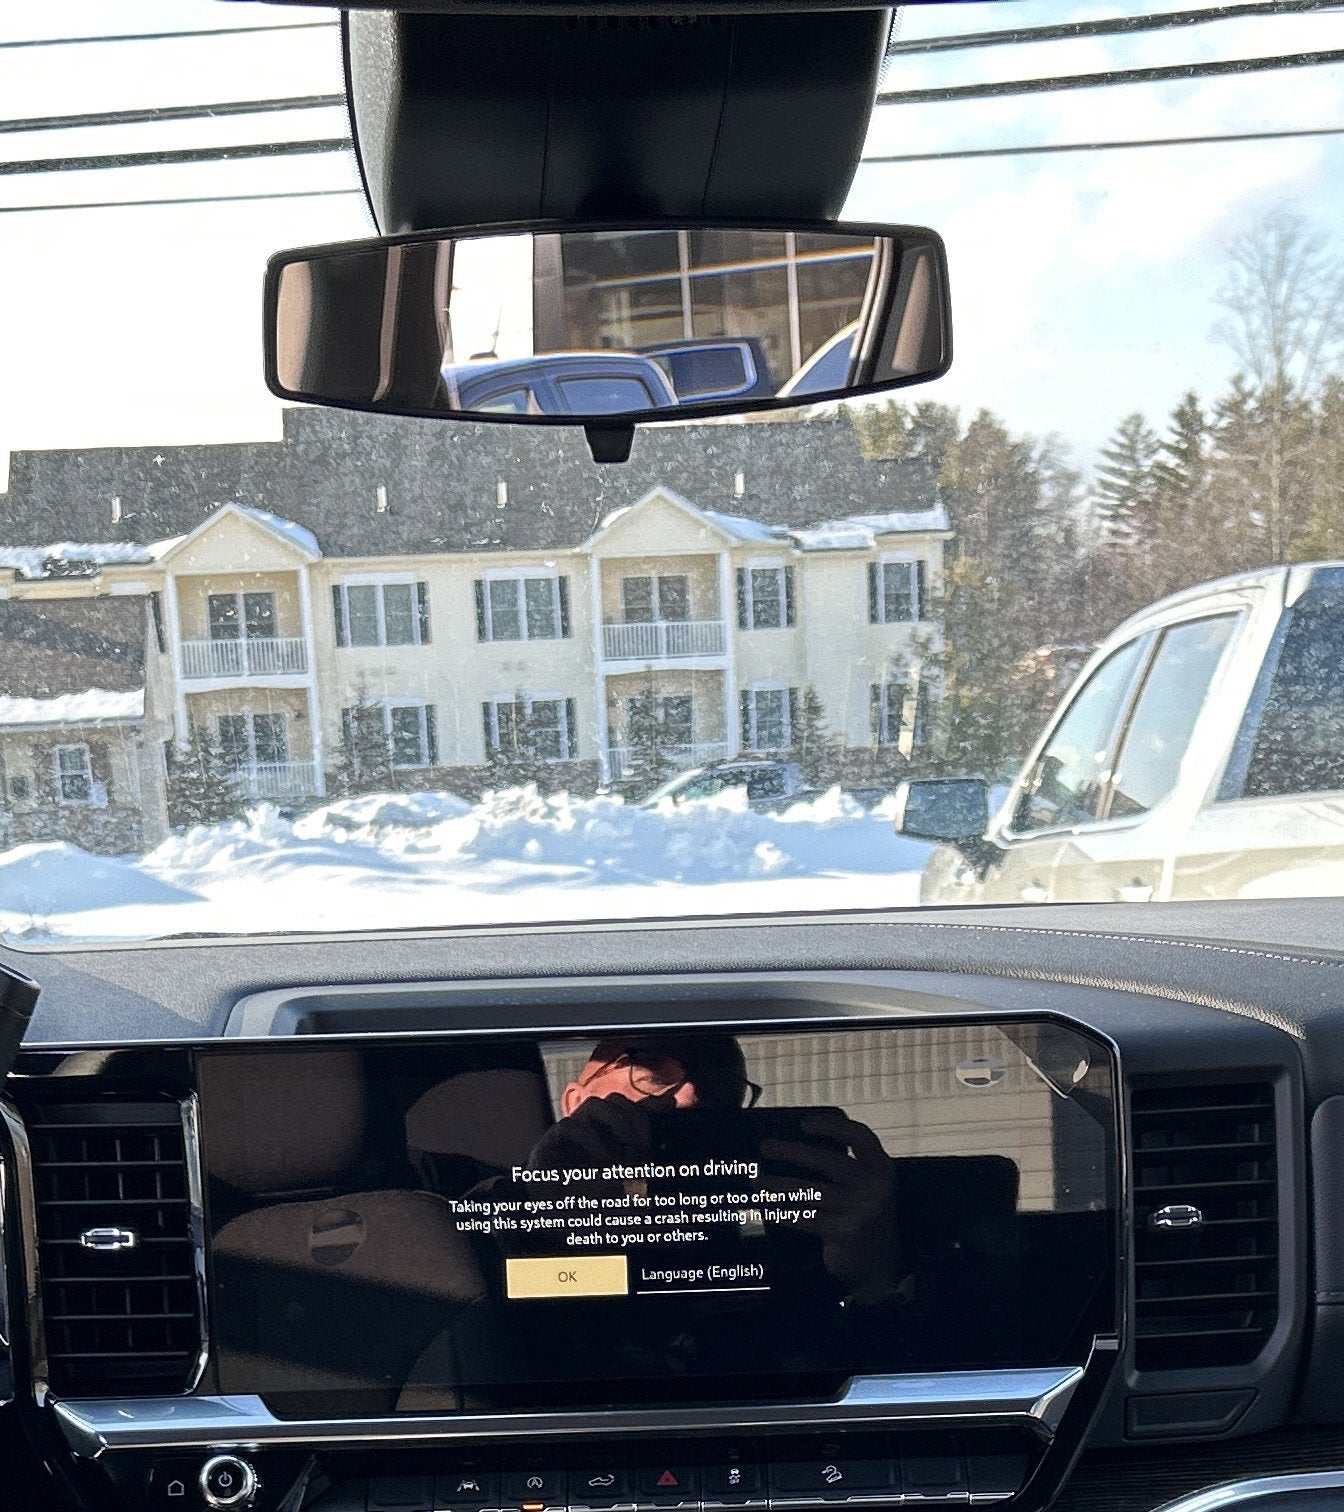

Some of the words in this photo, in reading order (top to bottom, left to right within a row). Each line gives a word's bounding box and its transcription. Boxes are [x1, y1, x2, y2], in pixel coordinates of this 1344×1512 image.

[512, 1166, 560, 1182] Focus
[562, 1168, 599, 1185] your
[602, 1162, 675, 1179] attention
[679, 1164, 700, 1177] on
[703, 1159, 759, 1179] driving
[449, 1200, 491, 1215] Taking
[493, 1201, 522, 1215] your
[524, 1200, 554, 1214] eyes
[556, 1196, 576, 1210] off
[577, 1196, 599, 1209] the
[601, 1194, 630, 1208] road
[633, 1194, 652, 1207] for
[654, 1194, 676, 1206] too
[679, 1192, 707, 1208] long
[710, 1194, 724, 1205] or
[726, 1192, 748, 1204] too
[751, 1189, 786, 1203] often
[788, 1188, 822, 1202] while
[456, 1218, 491, 1234] using
[492, 1216, 518, 1230] this
[520, 1216, 565, 1232] system
[567, 1213, 602, 1227] could
[605, 1214, 642, 1226] cause
[644, 1215, 652, 1225] a
[654, 1210, 689, 1225] crash
[691, 1209, 747, 1225] resulting
[749, 1208, 762, 1221] in
[764, 1207, 800, 1223] injury
[802, 1209, 817, 1219] or
[566, 1231, 603, 1245] death
[605, 1232, 619, 1244] to
[621, 1232, 644, 1247] you
[647, 1232, 661, 1243] or
[663, 1228, 709, 1243] others.
[558, 1270, 578, 1283] OK
[641, 1267, 704, 1283] Language
[706, 1263, 764, 1281] (English)
